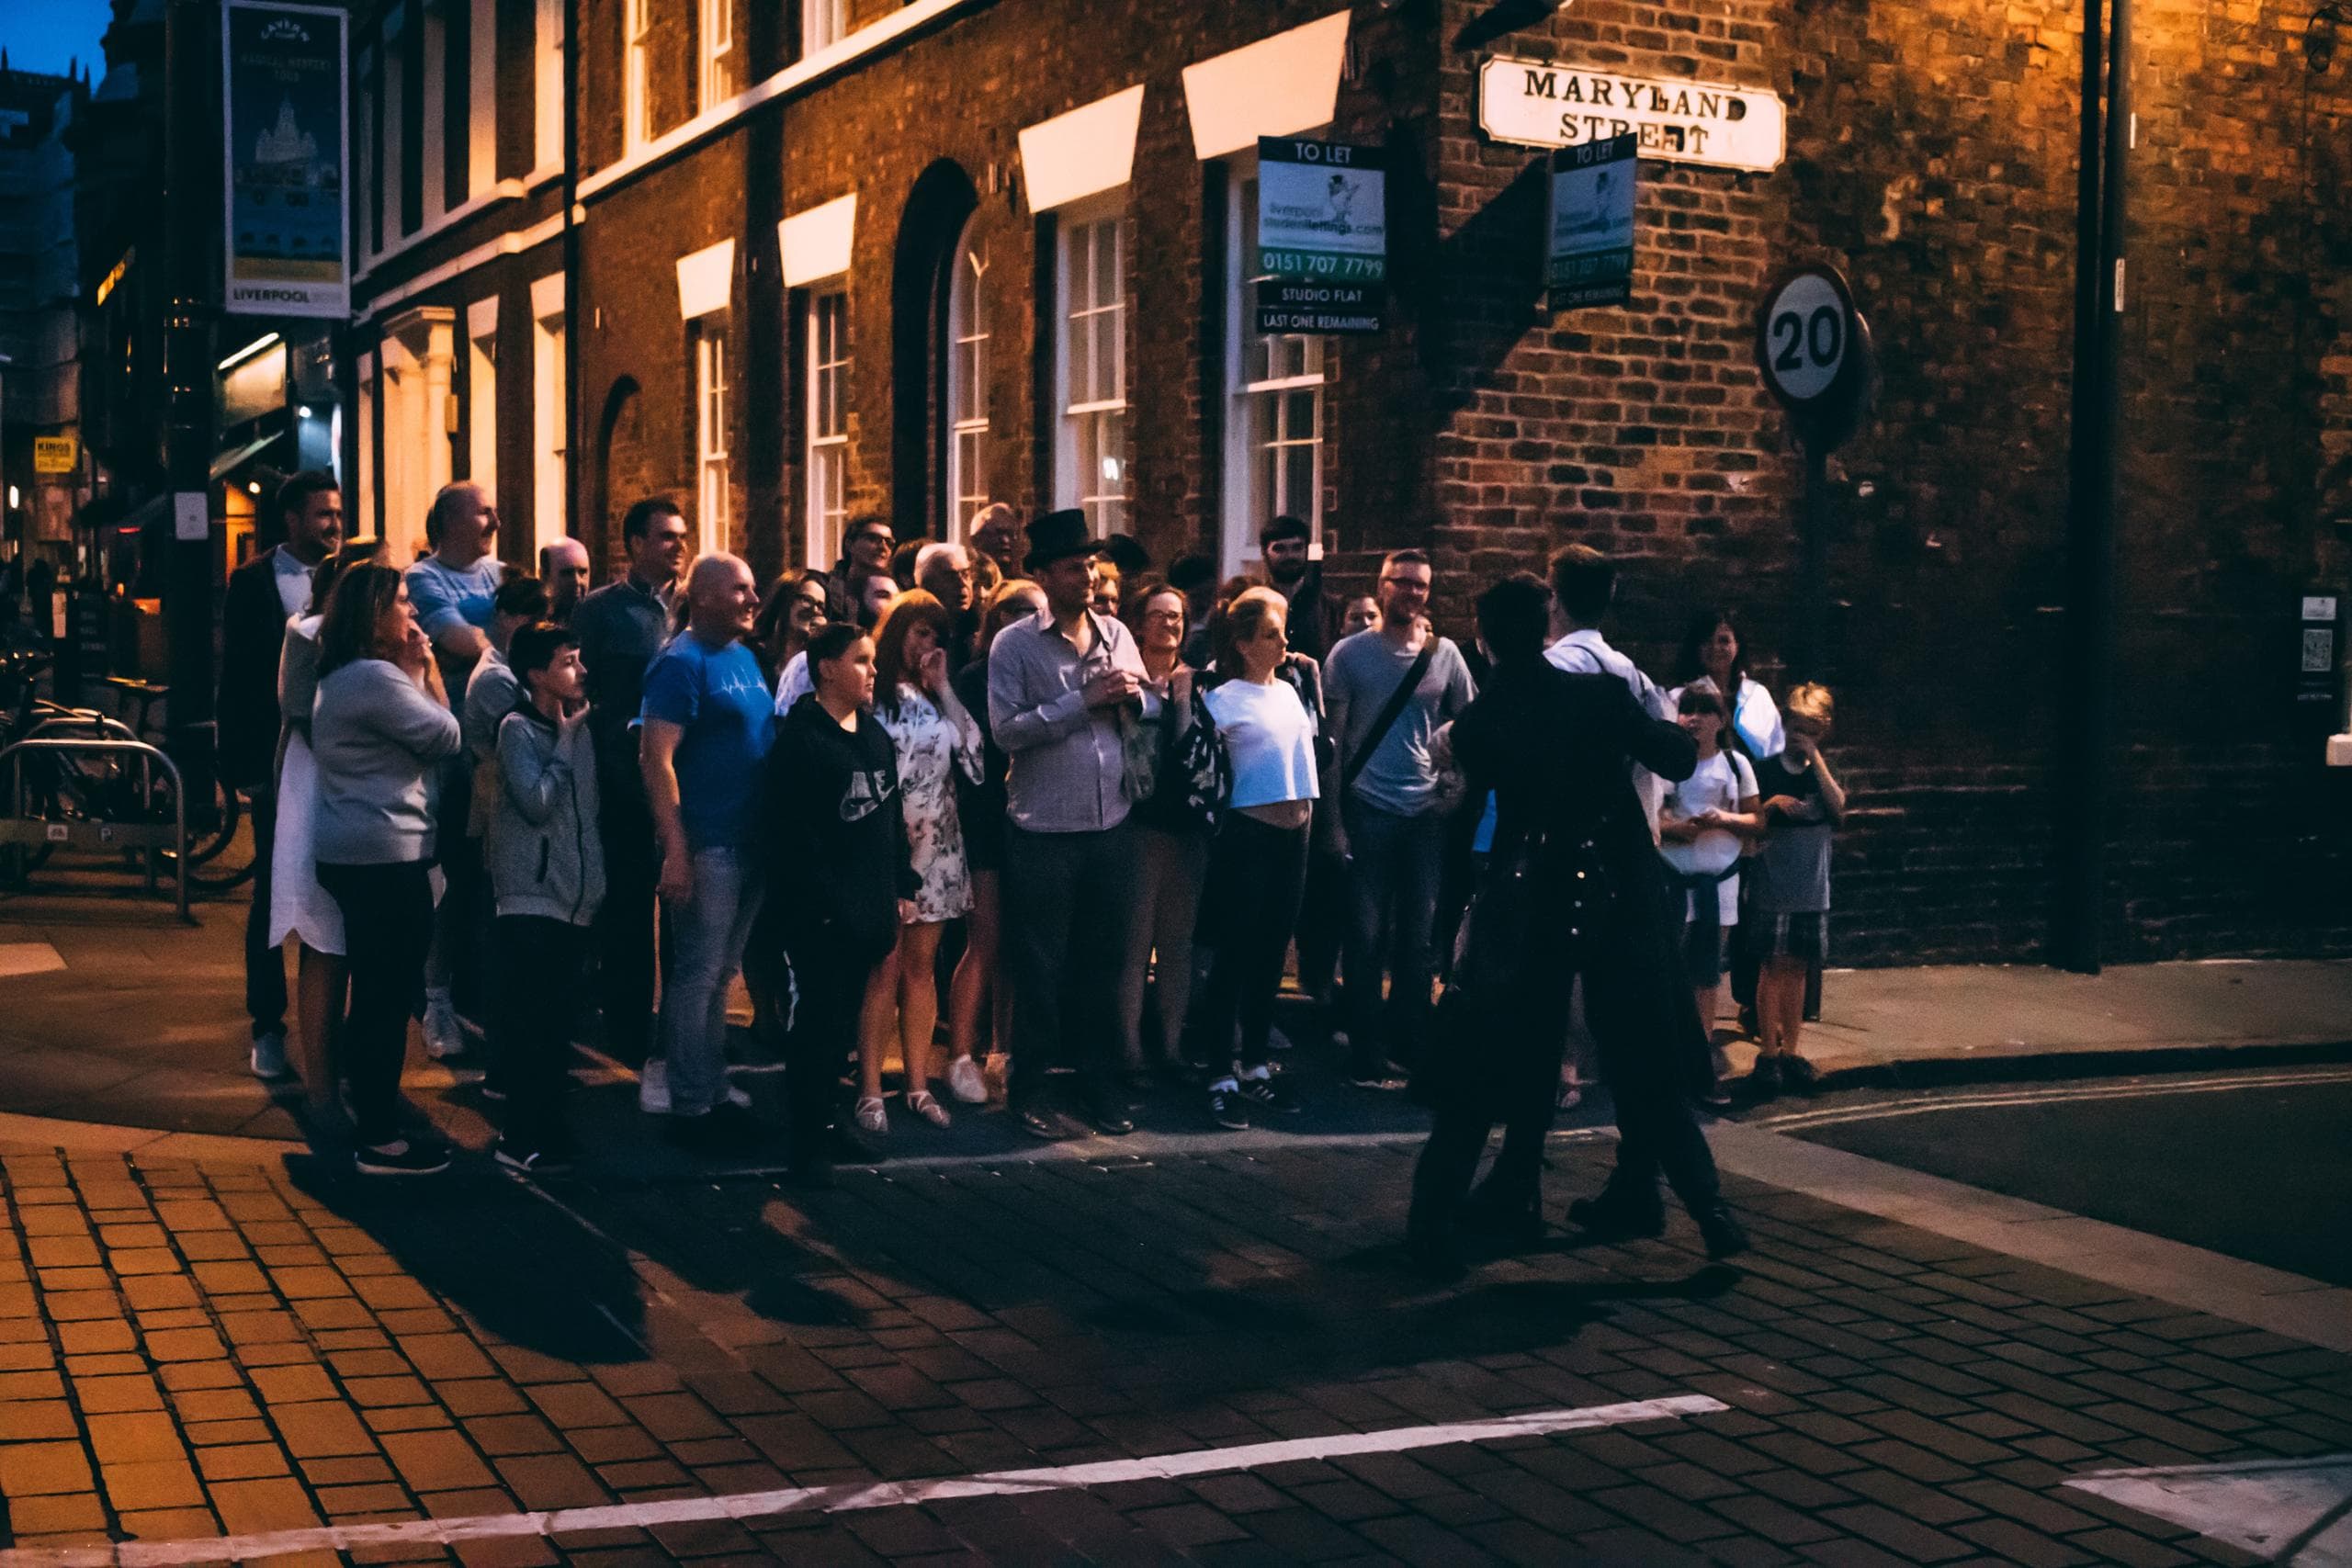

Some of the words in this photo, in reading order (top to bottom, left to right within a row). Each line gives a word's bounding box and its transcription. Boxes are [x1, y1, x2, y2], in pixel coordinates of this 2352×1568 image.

[1523, 69, 1747, 121] MARYLAND
[1294, 141, 1320, 162] TO
[1325, 145, 1352, 164] LET
[1576, 145, 1593, 164] TO
[1596, 140, 1614, 163] LET
[1263, 252, 1303, 273] 0151
[1306, 254, 1339, 275] 707
[1343, 257, 1384, 278] 7799
[232, 288, 311, 304] LIVERPOOL
[1281, 287, 1330, 302] STUDIO
[1333, 288, 1363, 302] FLAT
[1263, 314, 1288, 328] LAST
[1290, 315, 1316, 329] ONE
[1317, 315, 1380, 331] REMAINING
[1773, 305, 1841, 371] 20
